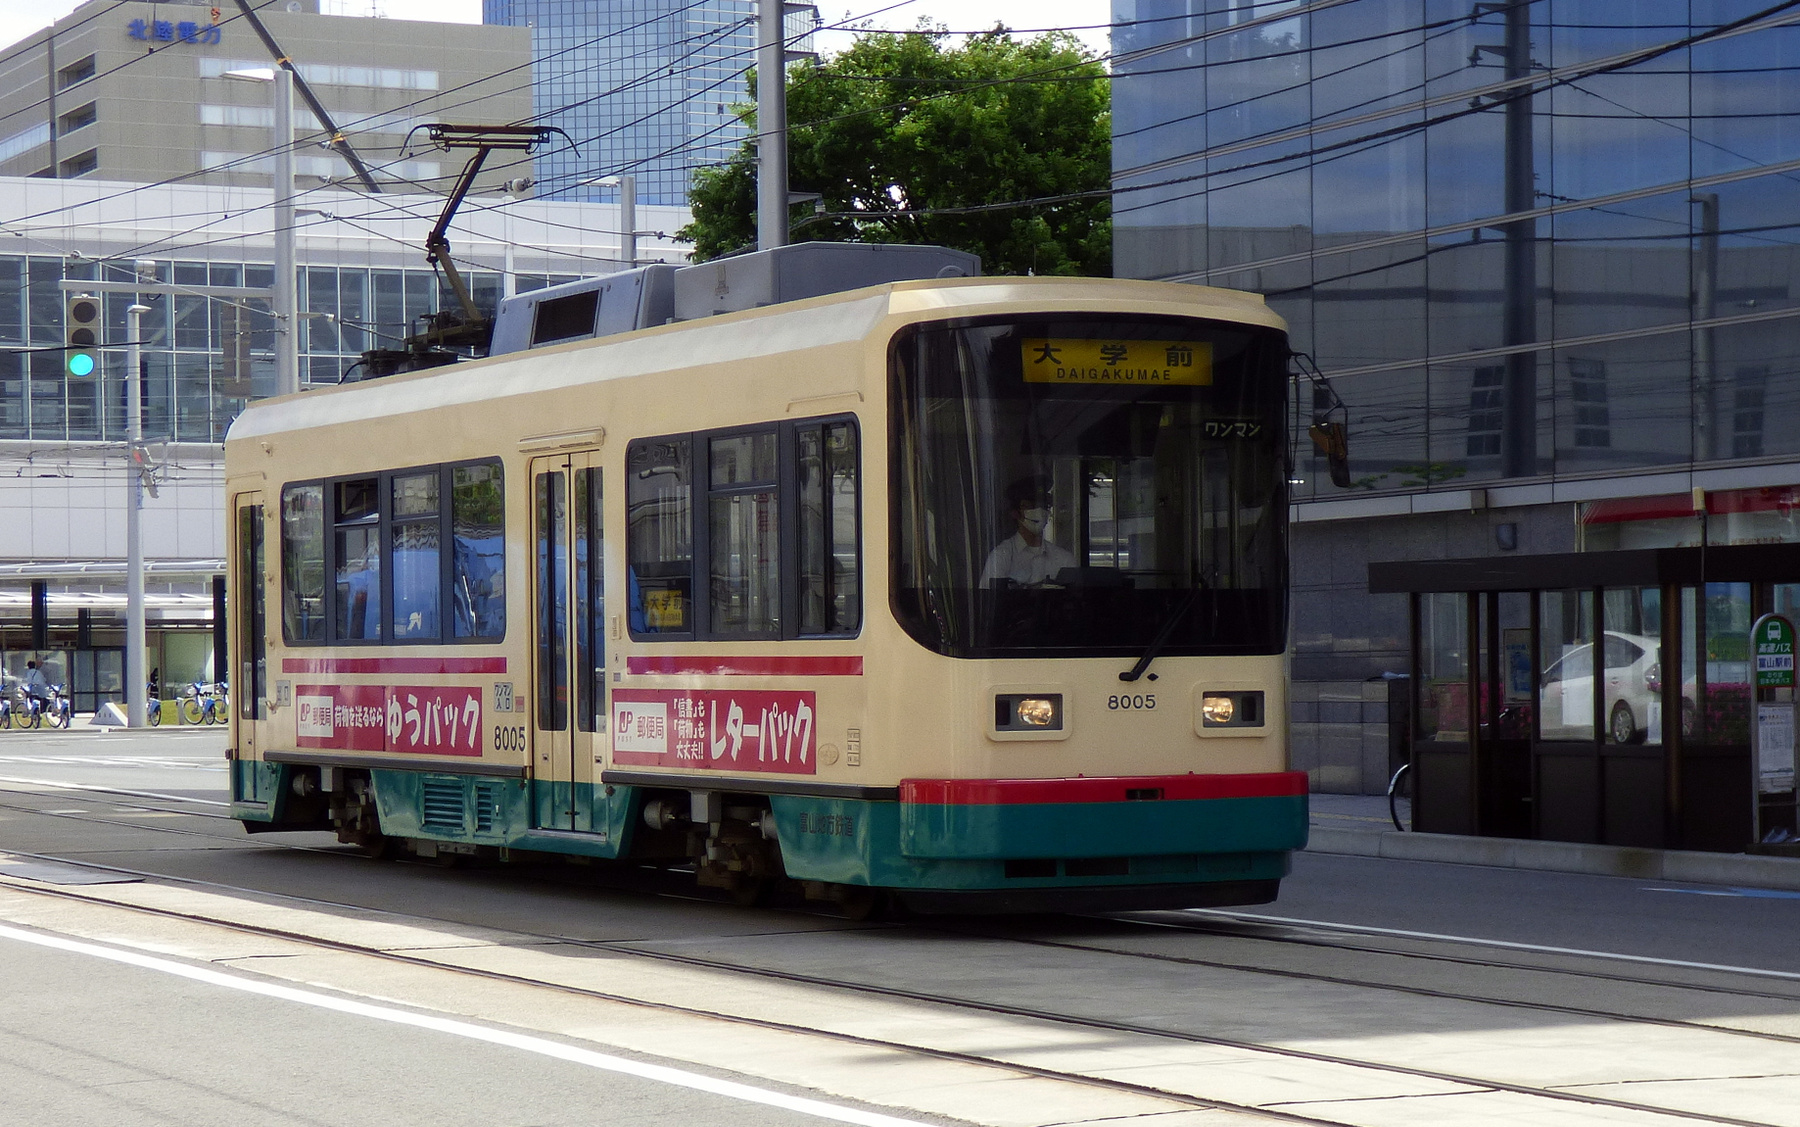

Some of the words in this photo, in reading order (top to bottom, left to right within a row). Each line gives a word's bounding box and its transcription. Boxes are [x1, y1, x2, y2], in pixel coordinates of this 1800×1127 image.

[127, 18, 222, 45] 北陸電力
[1033, 342, 1194, 368] 大学前
[1056, 367, 1172, 381] DAIGAKUMAE
[1204, 421, 1262, 438] ワンマン
[649, 593, 683, 611] 大学前
[1107, 694, 1156, 710] 8005
[334, 704, 384, 729] 荷物を送るなら
[386, 693, 481, 749] ゆうパック
[637, 715, 665, 740] 郵便局
[494, 725, 526, 752] 8005
[710, 698, 813, 764] レターパック
